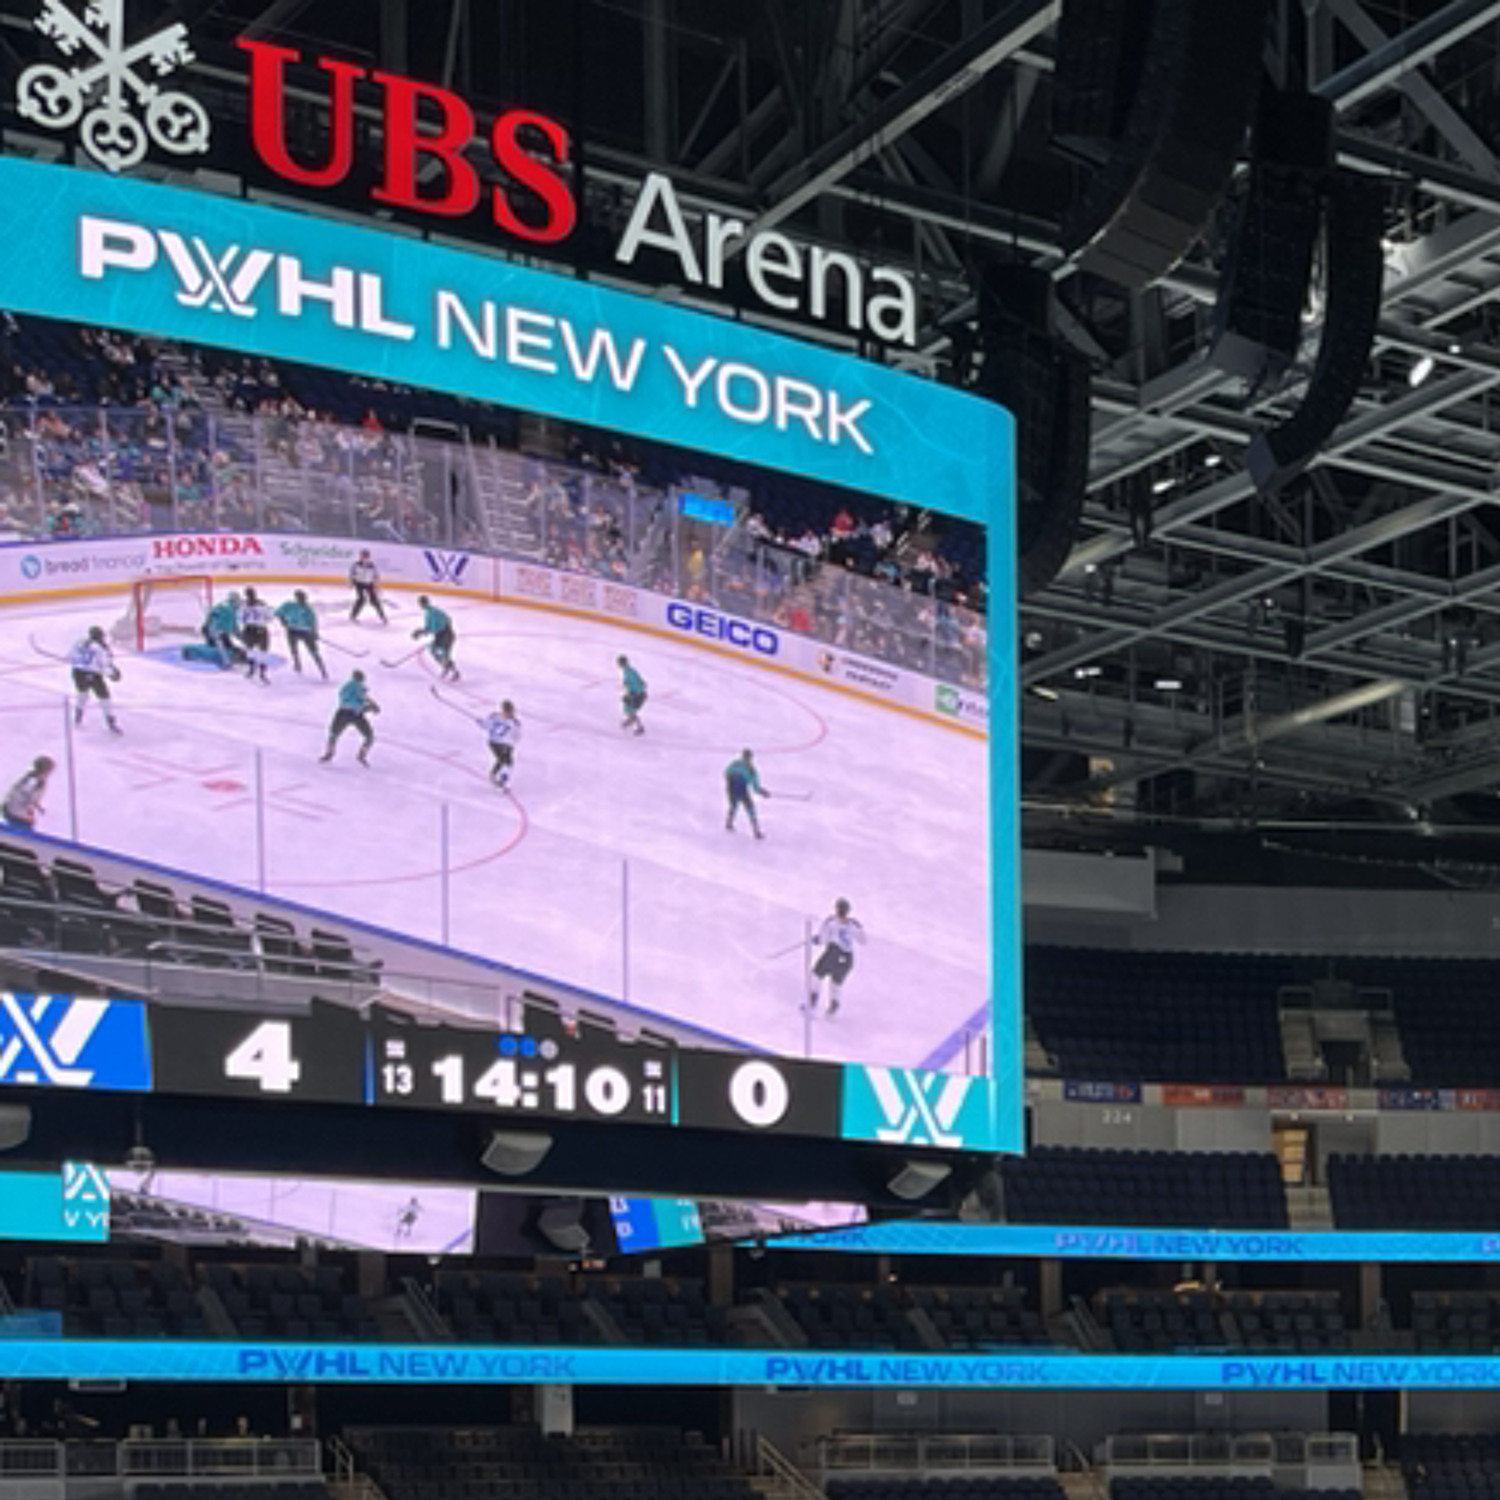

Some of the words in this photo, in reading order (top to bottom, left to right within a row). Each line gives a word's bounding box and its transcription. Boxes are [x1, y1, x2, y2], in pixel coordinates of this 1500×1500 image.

[236, 36, 578, 245] UBS
[615, 171, 918, 346] Arena
[78, 215, 414, 340] PWHL
[436, 290, 645, 392] NEW
[663, 343, 875, 454] YORK
[151, 536, 265, 560] HONDA
[666, 602, 779, 655] GEICO
[224, 1021, 301, 1094] 4
[383, 1064, 415, 1095] 13
[431, 1054, 632, 1116] 14:10
[729, 1060, 790, 1128] 0
[643, 1084, 667, 1115] 11
[1155, 1235, 1220, 1255] NEW
[1225, 1235, 1304, 1256] YORK
[238, 1348, 370, 1377] PWHL
[378, 1350, 470, 1377] NEW
[473, 1353, 577, 1379] YORK
[765, 1356, 872, 1381] PWHL
[879, 1359, 957, 1382] NEW
[960, 1360, 1050, 1383] YORK
[1220, 1361, 1329, 1385] PWHL
[1332, 1361, 1409, 1384] NEW
